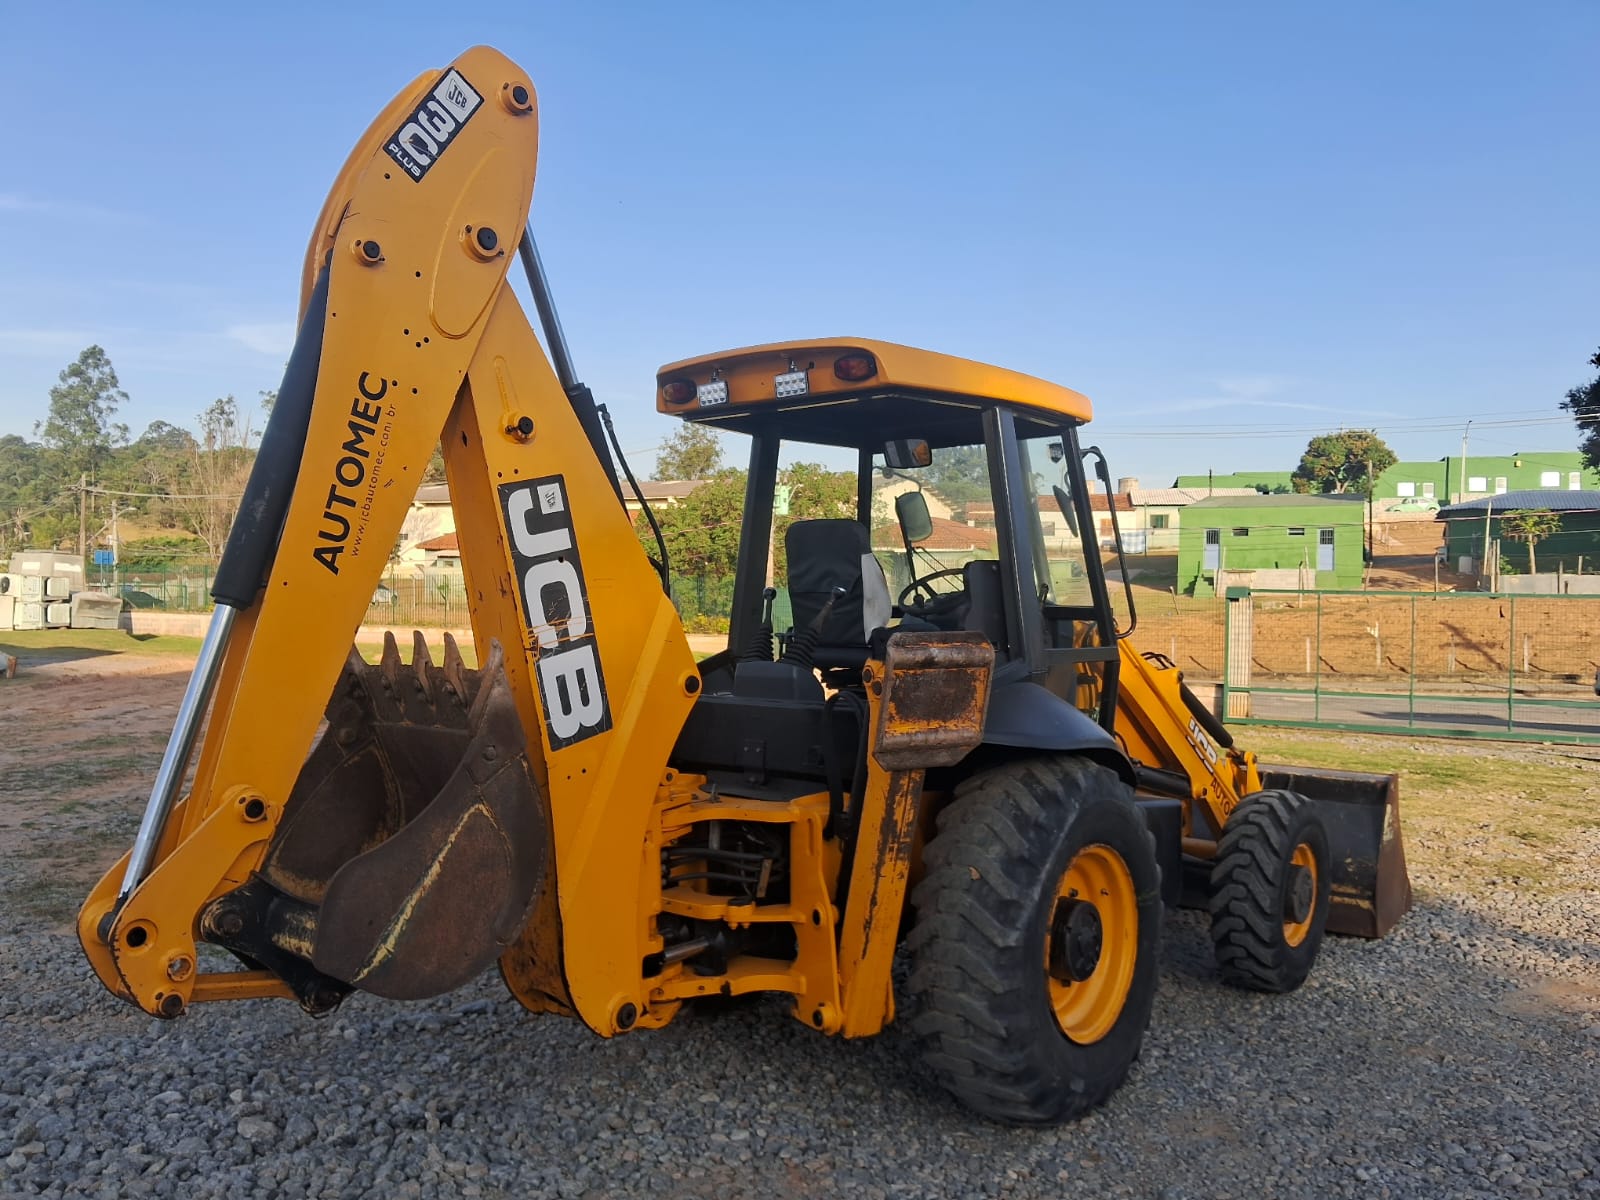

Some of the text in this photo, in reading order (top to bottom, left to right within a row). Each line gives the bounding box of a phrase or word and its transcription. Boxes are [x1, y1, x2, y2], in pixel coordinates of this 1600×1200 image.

[388, 142, 421, 177] PLUS
[447, 84, 468, 109] JCB
[312, 371, 388, 576] AUTOMEC
[351, 403, 397, 557] www.jcbautomec.combr
[507, 487, 603, 739] JCB
